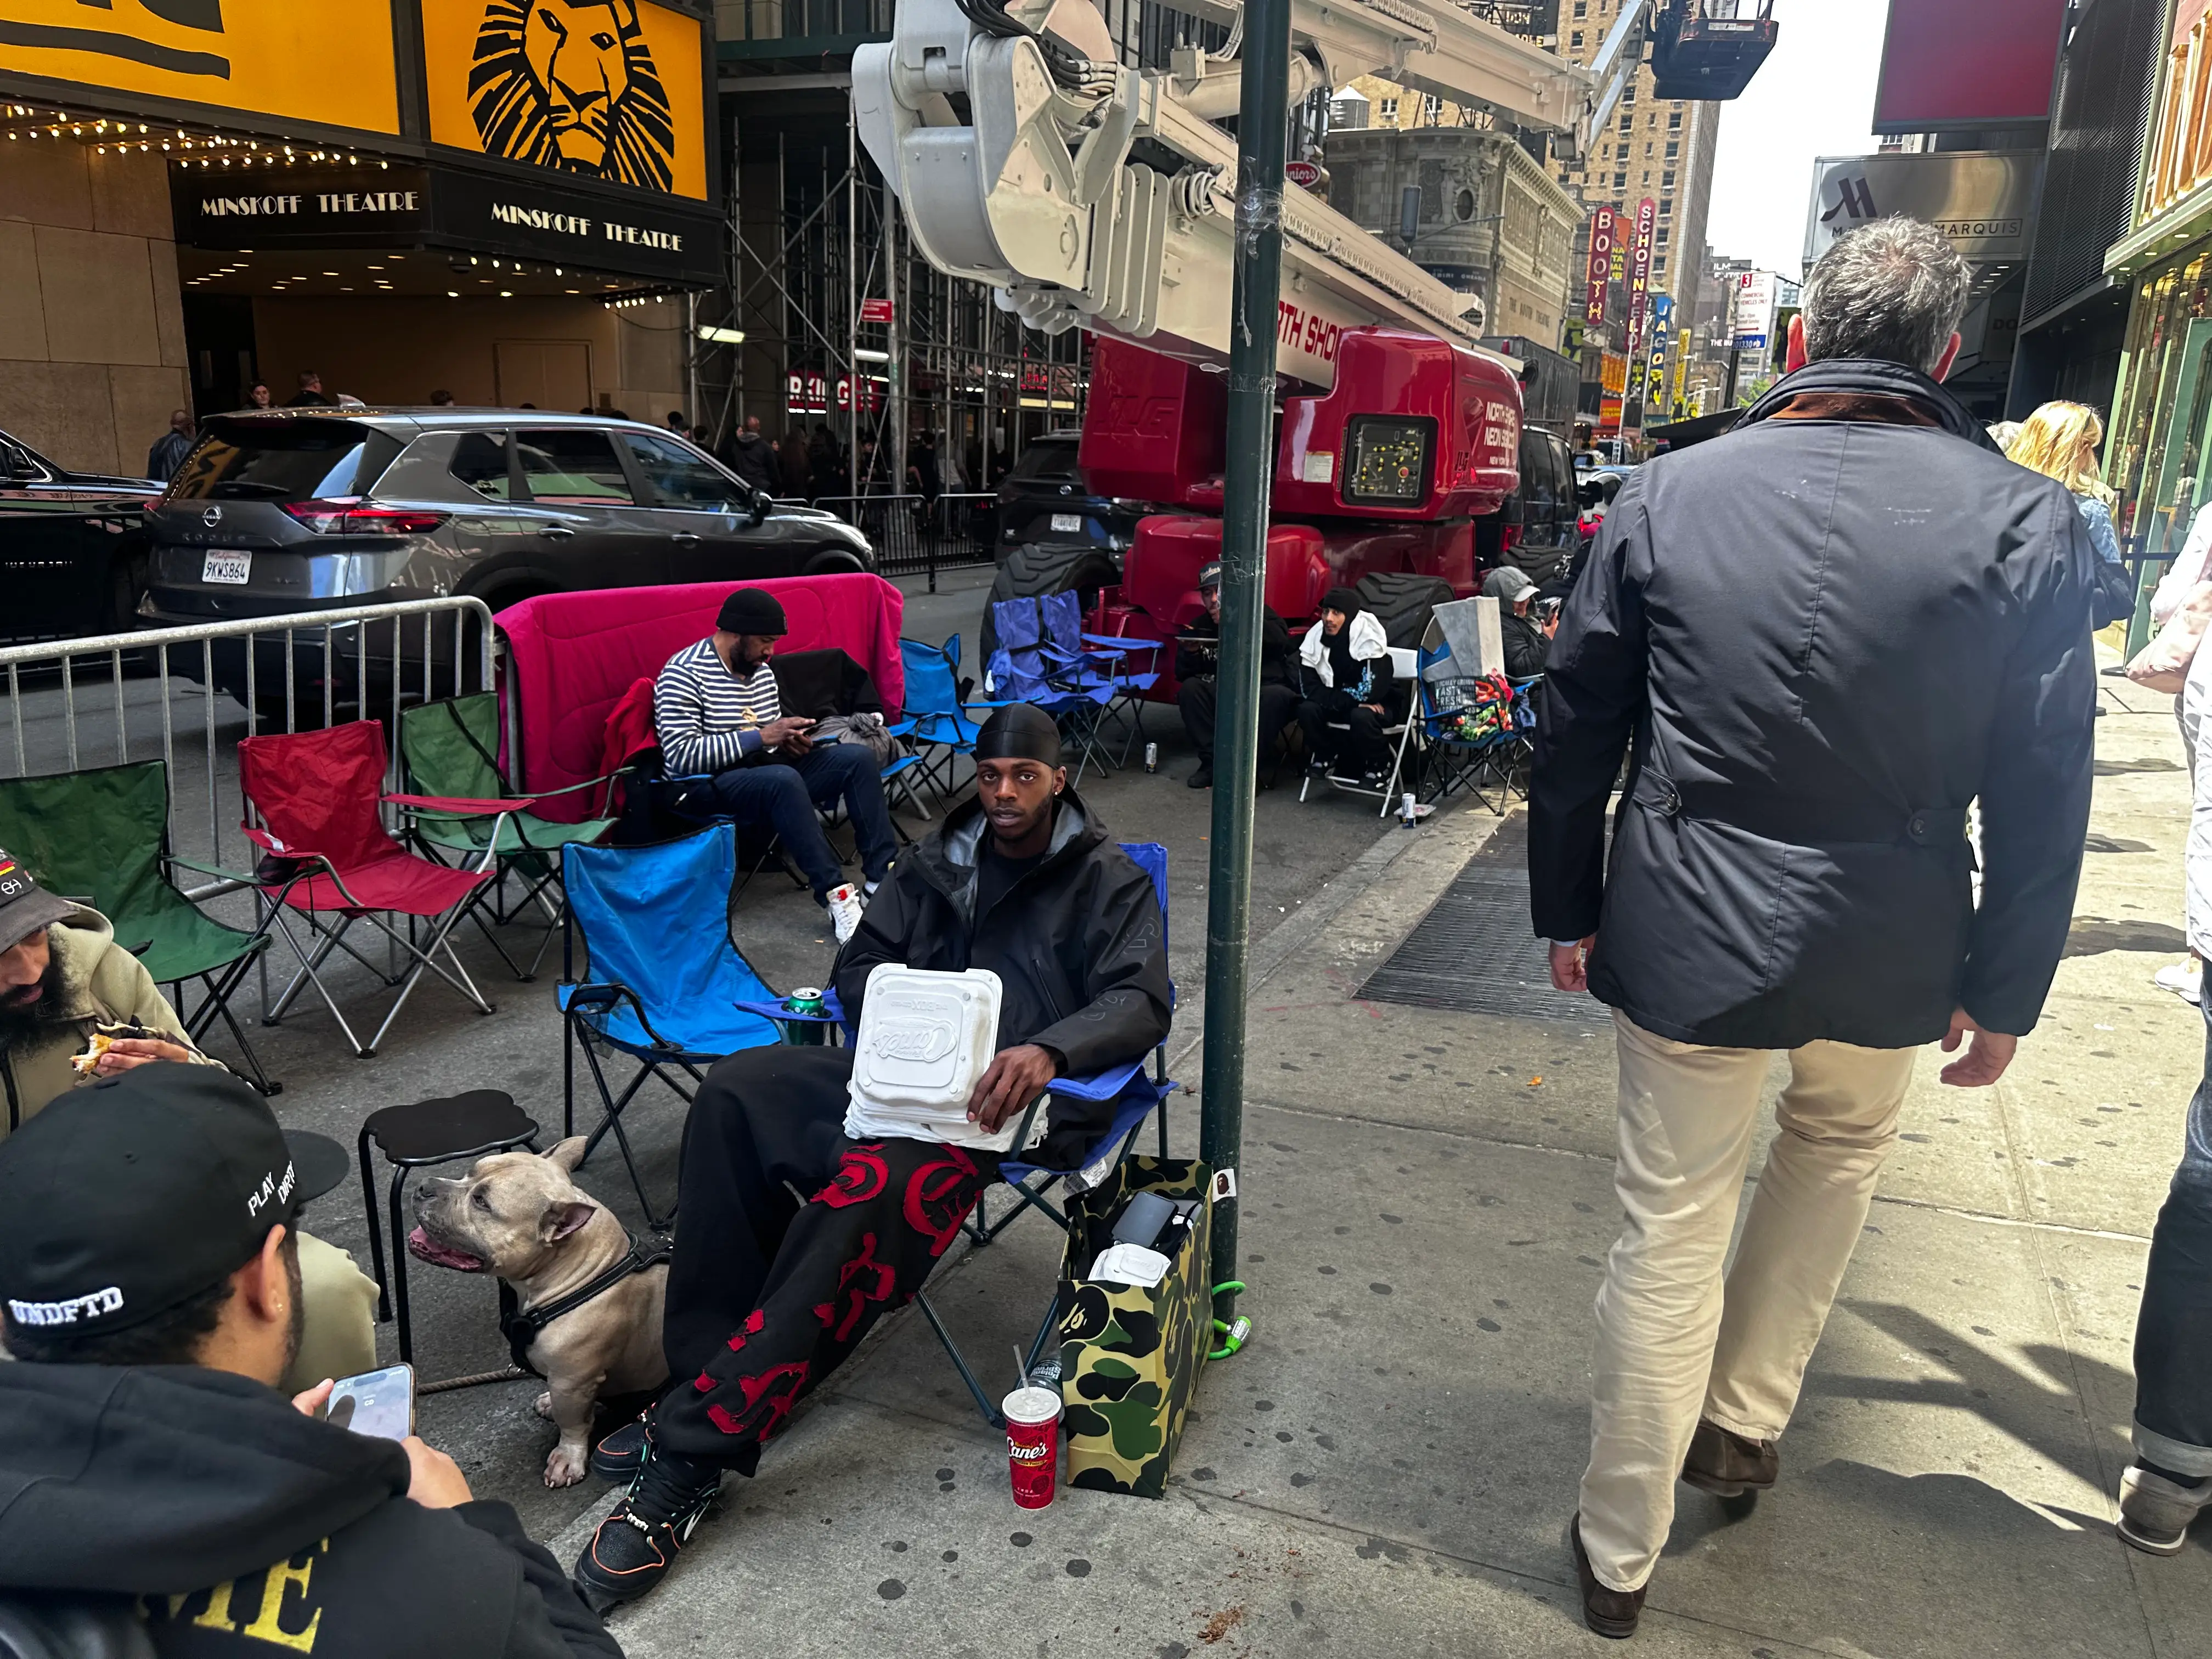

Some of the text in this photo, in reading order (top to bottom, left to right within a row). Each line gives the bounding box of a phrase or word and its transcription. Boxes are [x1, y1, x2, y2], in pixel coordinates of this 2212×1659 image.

[201, 191, 420, 216] MINSKOFF THEATRE
[491, 202, 683, 252] MINSKOFF THEATRE
[1588, 211, 1612, 320] BOOTH
[1627, 205, 1651, 346] SCHOENFELD
[1743, 275, 1751, 287] 3
[206, 561, 246, 579] 9KWS864
[247, 1171, 275, 1216] PLAY
[8, 1286, 124, 1326] UNDFTD
[1007, 1436, 1049, 1459] Cane's
